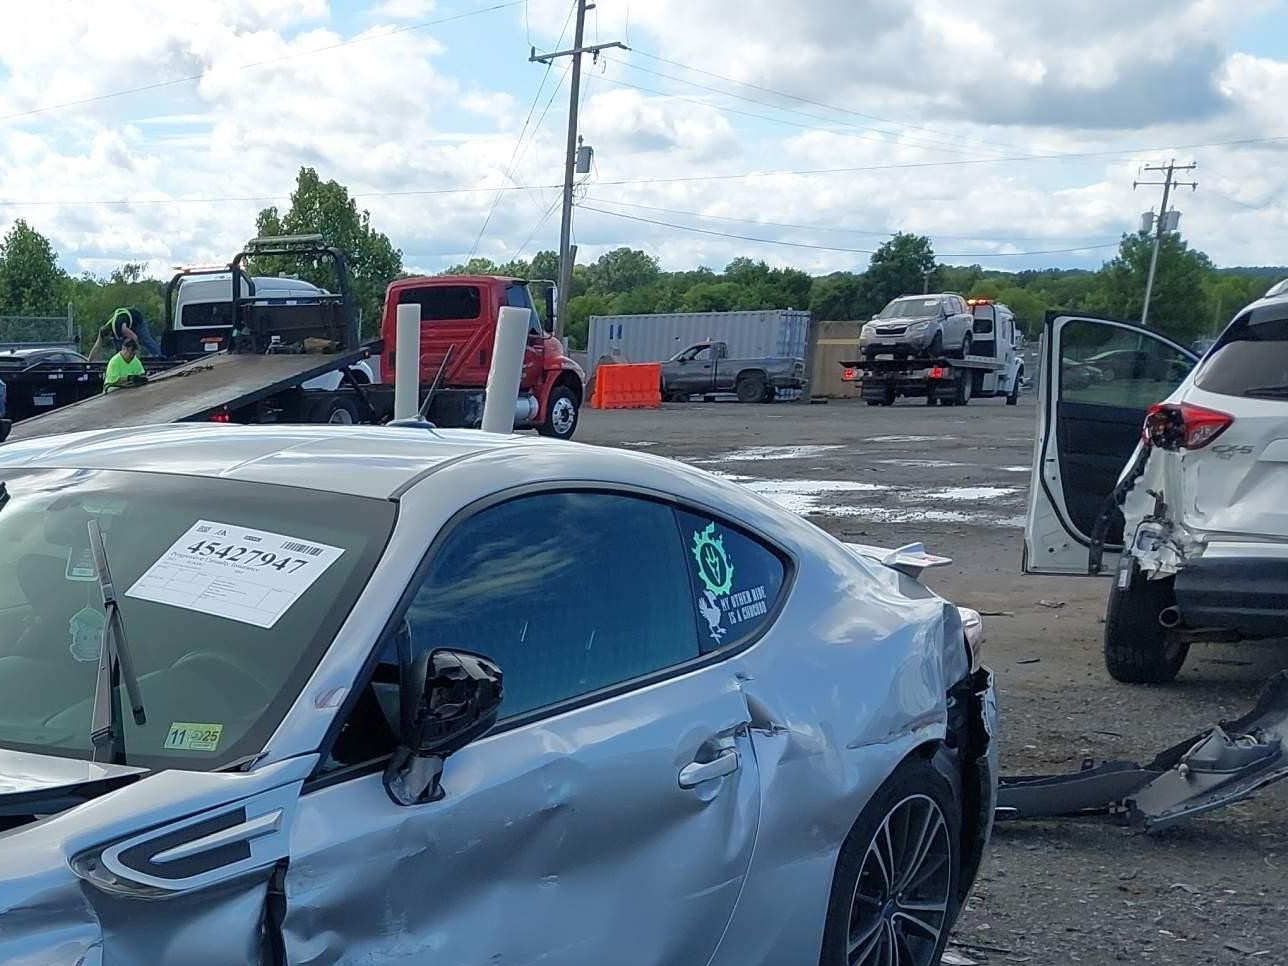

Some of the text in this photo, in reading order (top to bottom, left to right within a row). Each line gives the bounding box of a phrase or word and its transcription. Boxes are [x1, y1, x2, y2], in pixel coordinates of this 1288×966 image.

[187, 540, 309, 574] 45427947
[730, 590, 752, 608] OTHER
[171, 729, 186, 744] 11
[202, 730, 219, 742] 25
